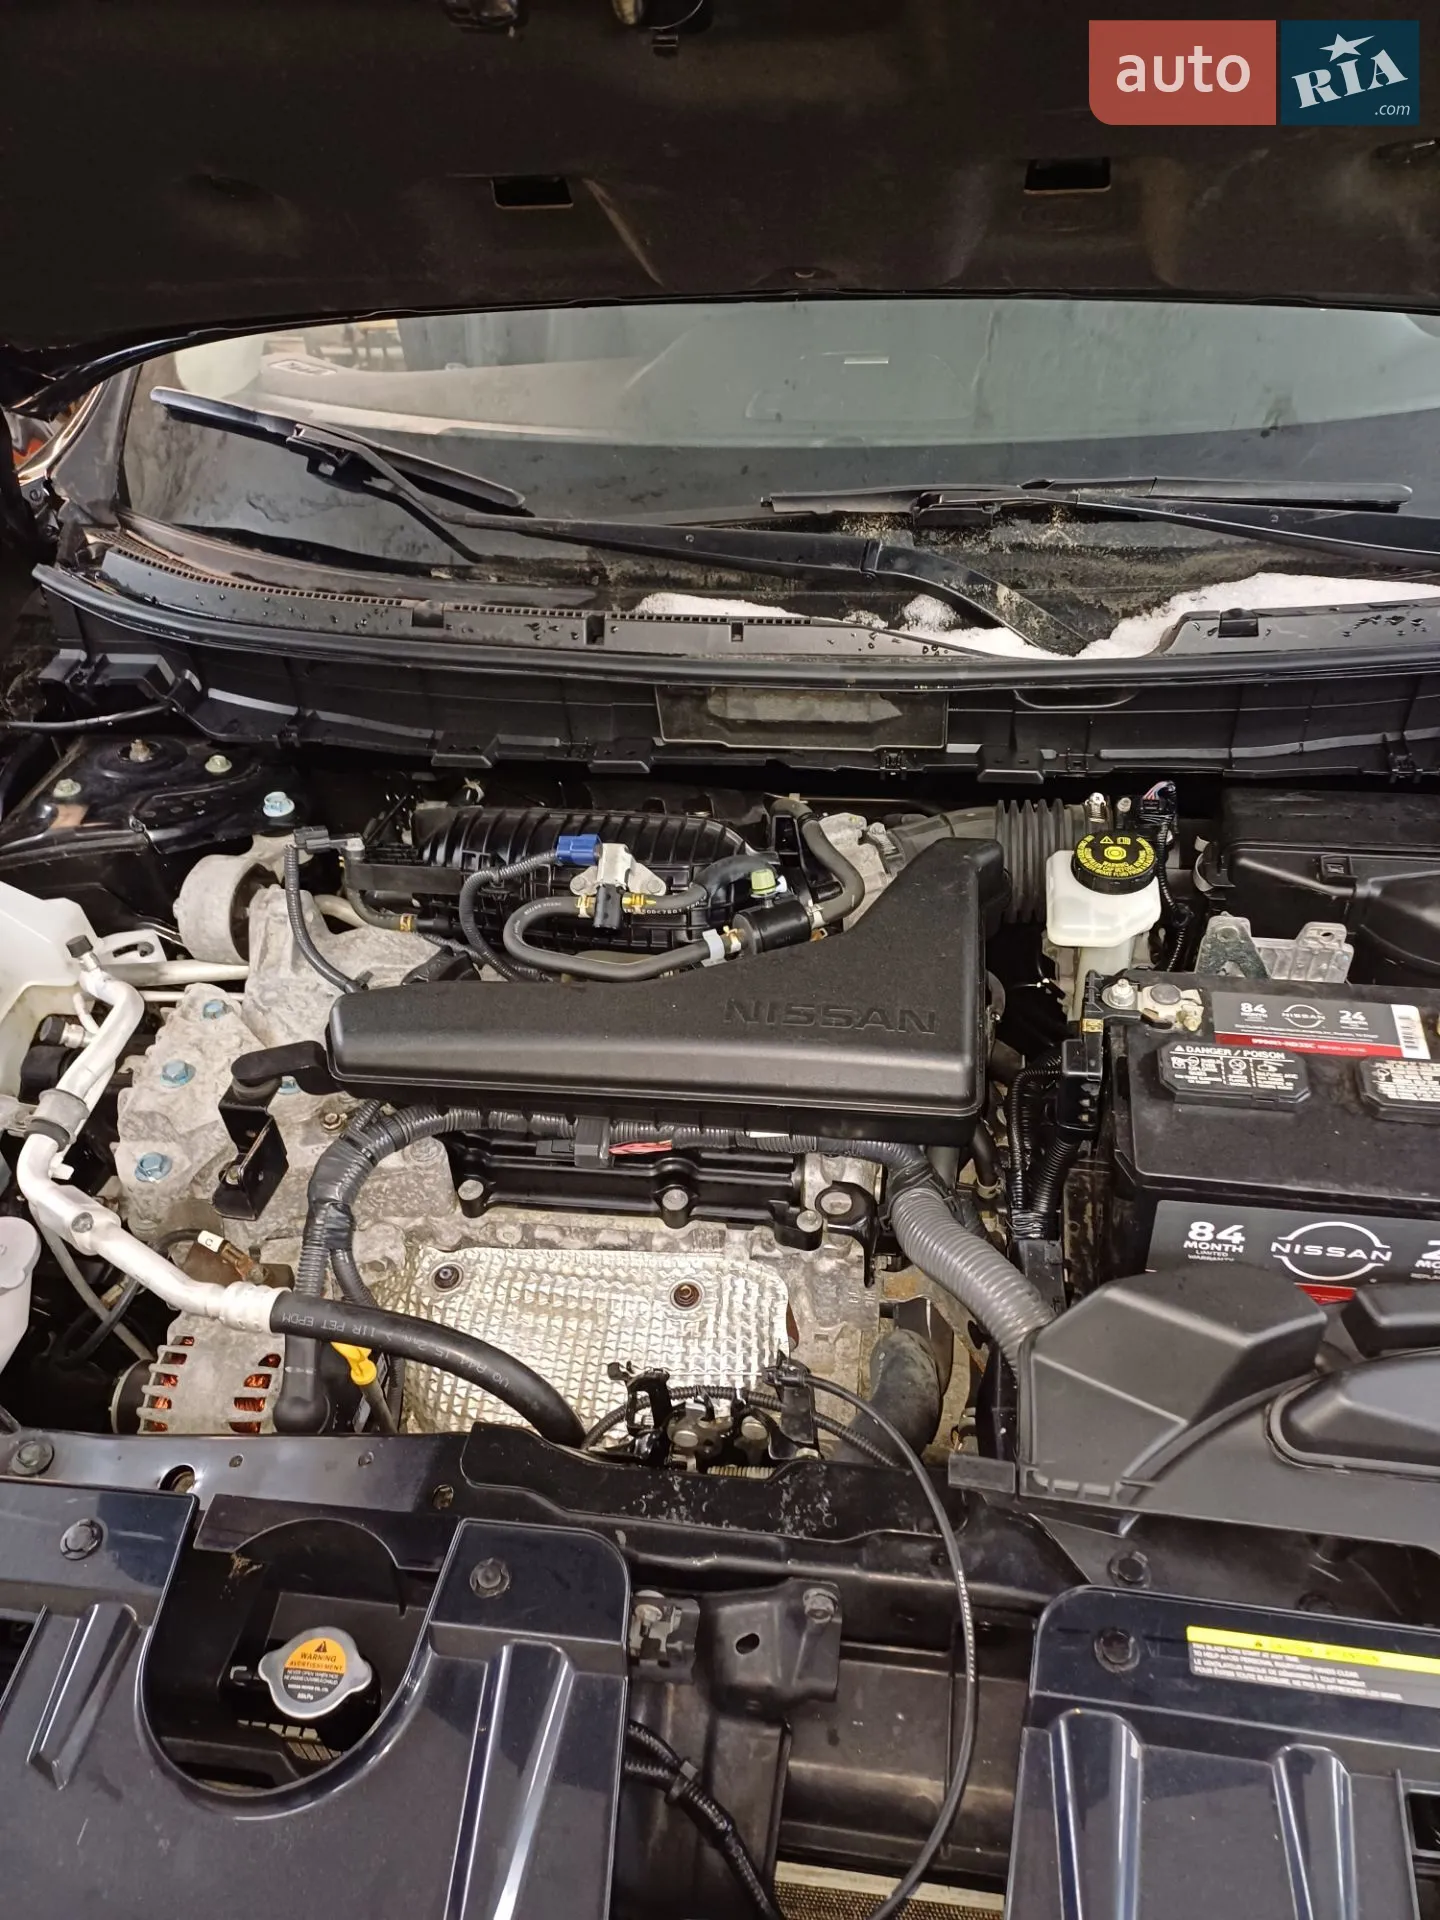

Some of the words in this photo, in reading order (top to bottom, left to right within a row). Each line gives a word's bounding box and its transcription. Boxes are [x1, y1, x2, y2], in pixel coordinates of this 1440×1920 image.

[1240, 1002, 1267, 1014] 84
[723, 998, 937, 1035] NISSAN
[1281, 1011, 1326, 1020] NISSAN
[1339, 1010, 1366, 1021] 24
[1185, 1045, 1232, 1056] DANGER
[1243, 1050, 1286, 1060] POISON
[1187, 1220, 1246, 1244] 84
[1183, 1240, 1245, 1253] MONTH
[1270, 1241, 1393, 1262] NISSAN
[320, 1319, 346, 1332] PET
[300, 1652, 337, 1663] WARNING
